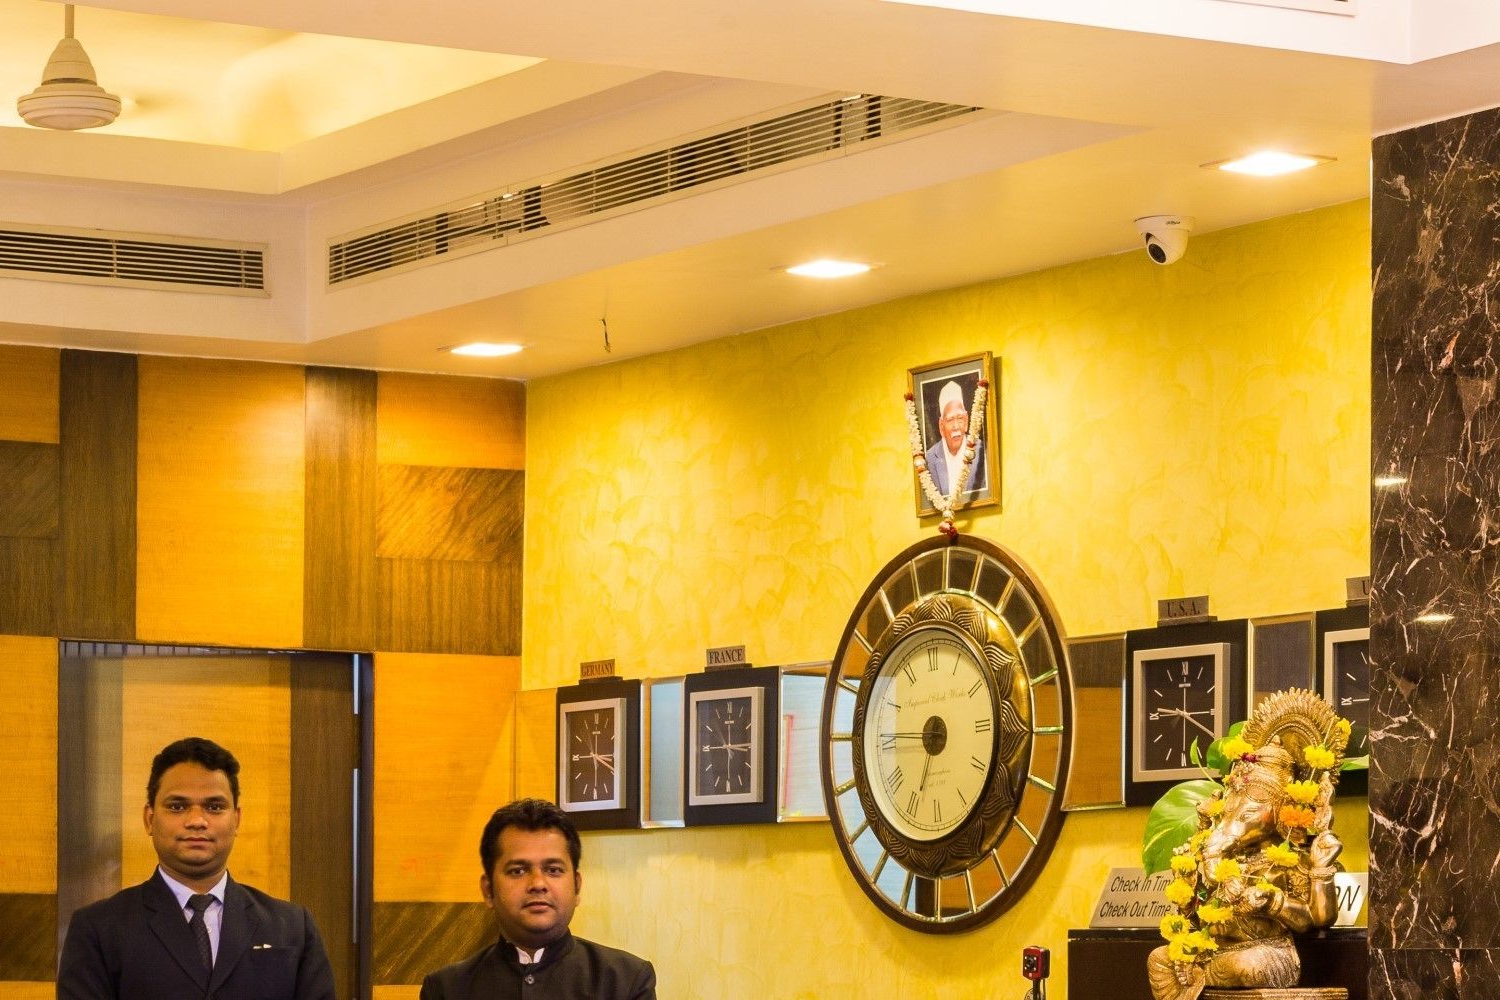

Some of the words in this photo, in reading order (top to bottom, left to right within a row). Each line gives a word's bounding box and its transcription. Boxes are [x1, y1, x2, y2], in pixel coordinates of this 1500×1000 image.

[709, 648, 743, 664] FRANCE
[581, 662, 614, 677] GERMANY
[1110, 876, 1141, 893] Check
[1140, 876, 1152, 892] In
[1153, 876, 1173, 892] Tim
[1100, 901, 1130, 918] Check
[1129, 901, 1148, 918] Out
[1148, 901, 1172, 918] Time
